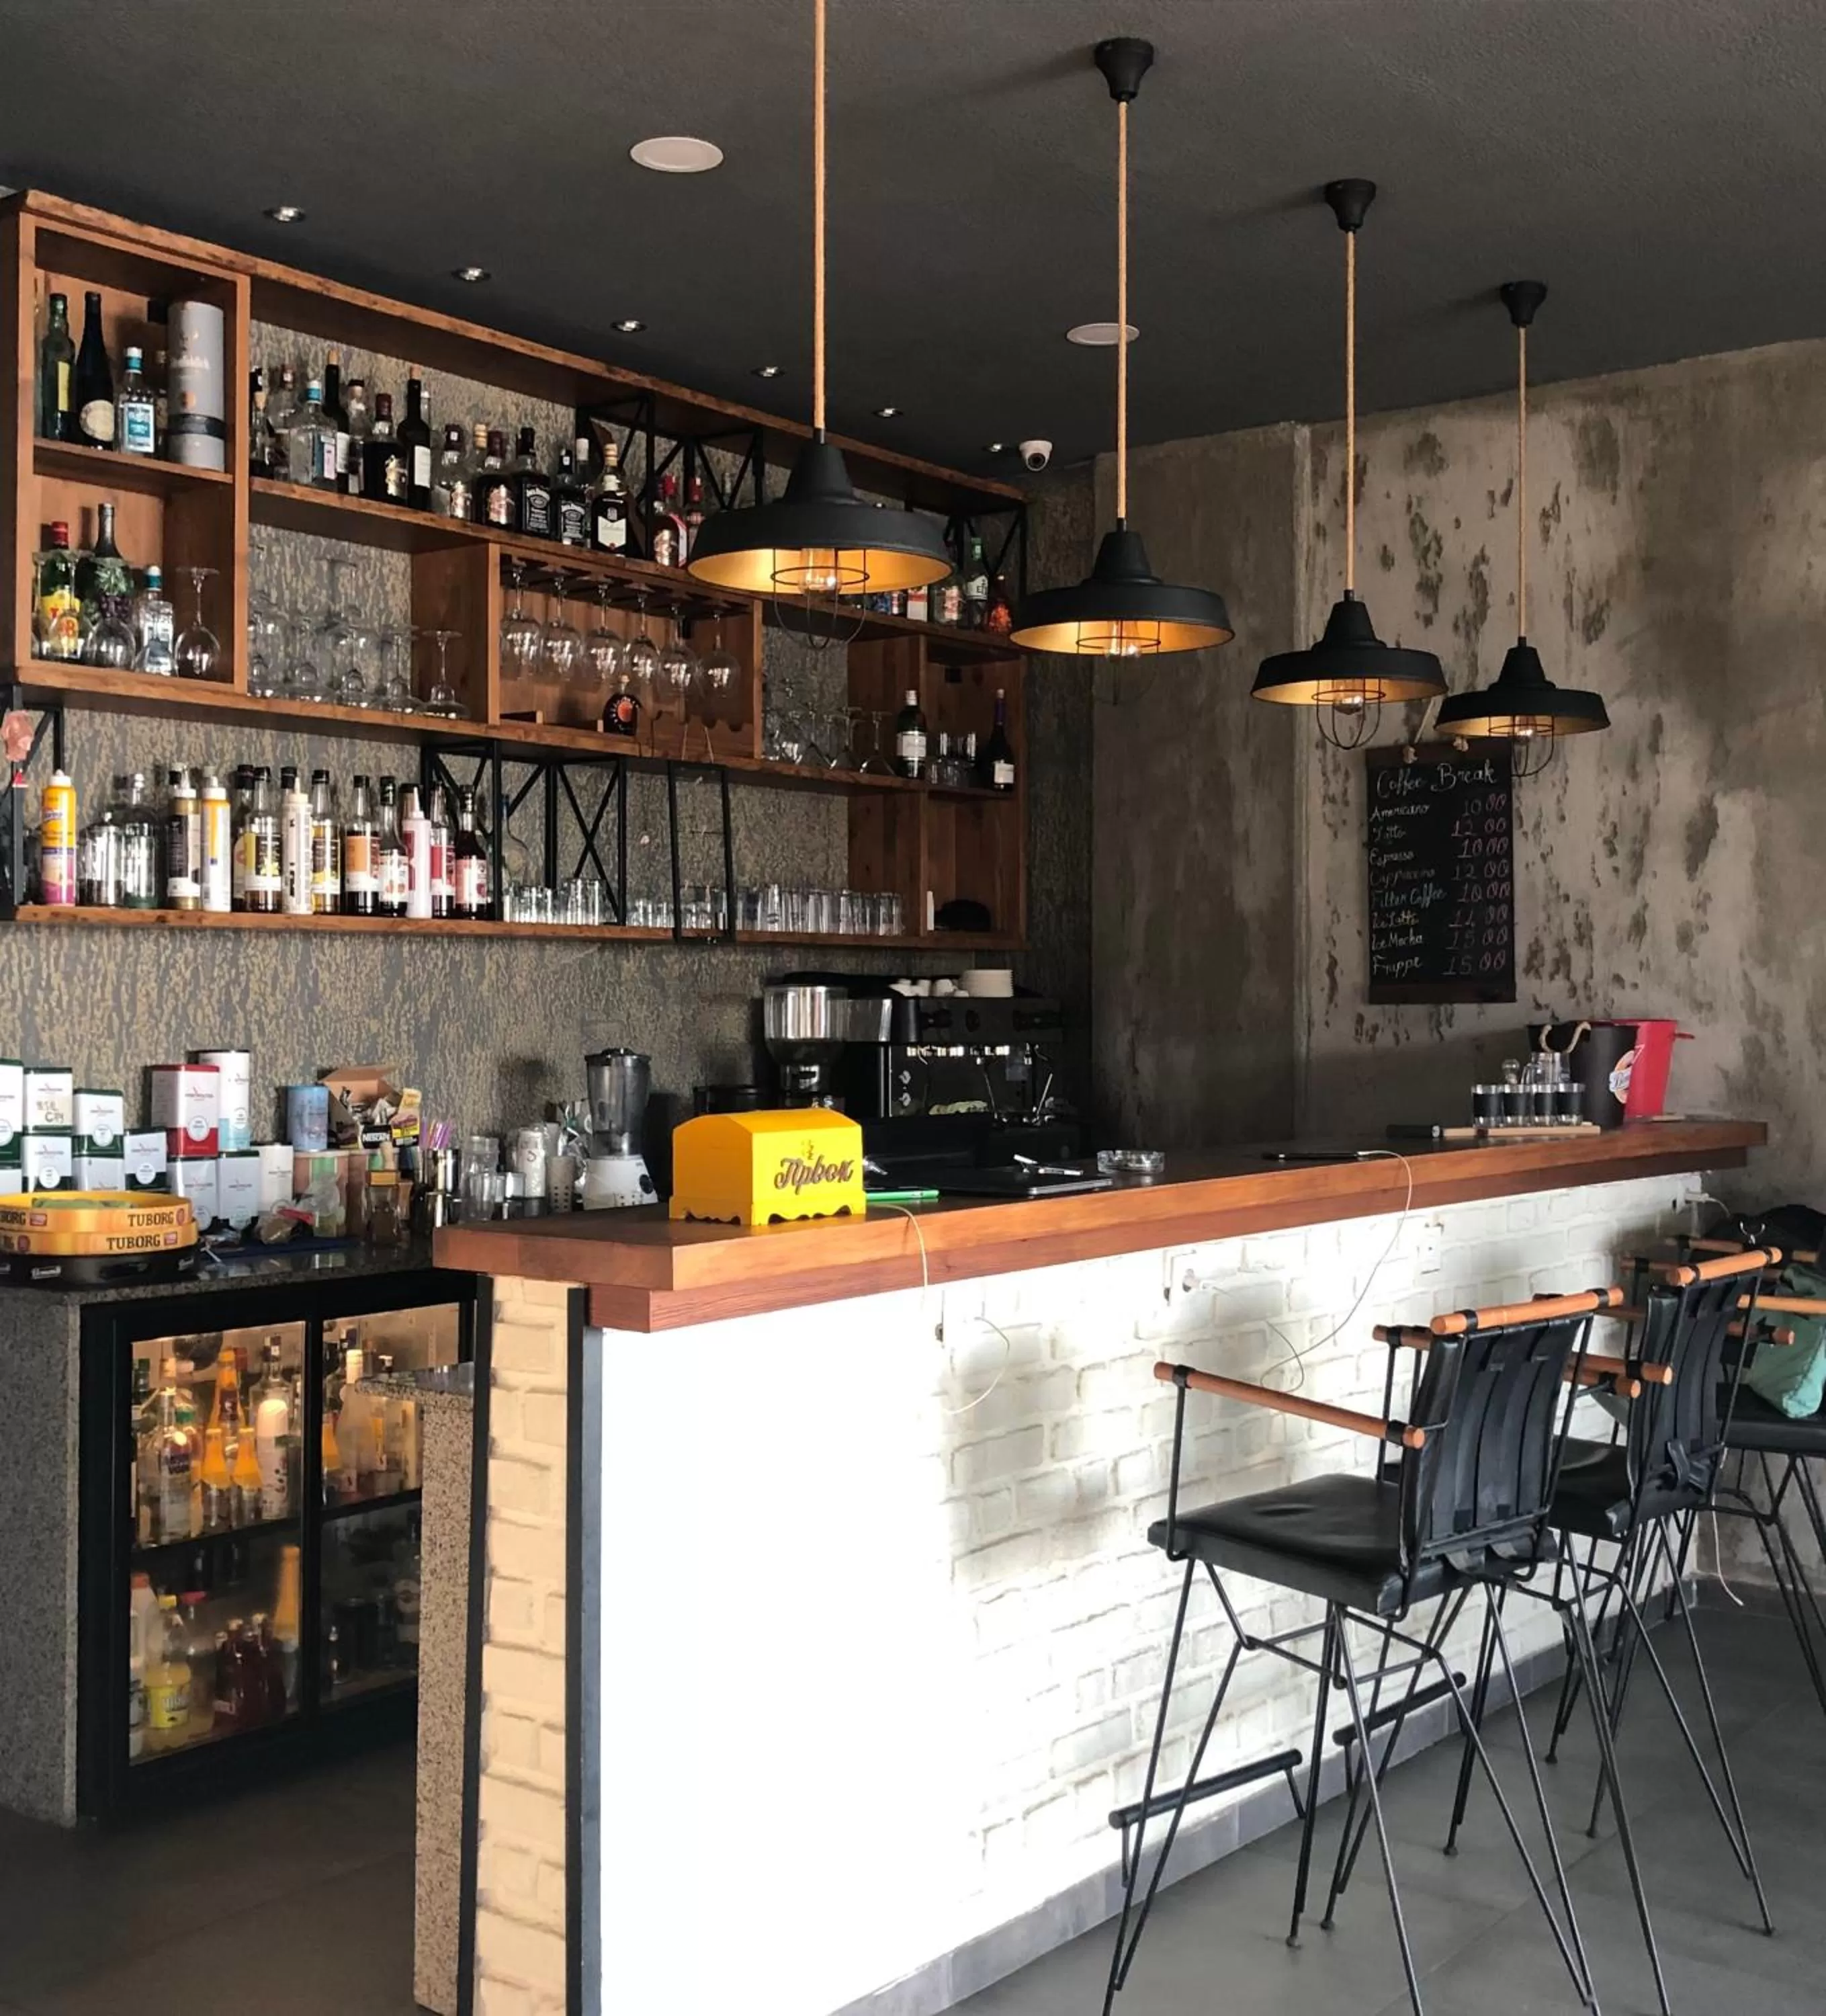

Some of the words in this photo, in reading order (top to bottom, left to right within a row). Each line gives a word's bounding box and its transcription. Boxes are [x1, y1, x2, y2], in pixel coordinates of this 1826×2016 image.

[1377, 768, 1426, 798] Coffee
[1430, 758, 1497, 792] Break
[1370, 804, 1430, 822] Americano
[128, 1211, 174, 1227] TUBORG
[106, 1234, 161, 1251] TUBORG
